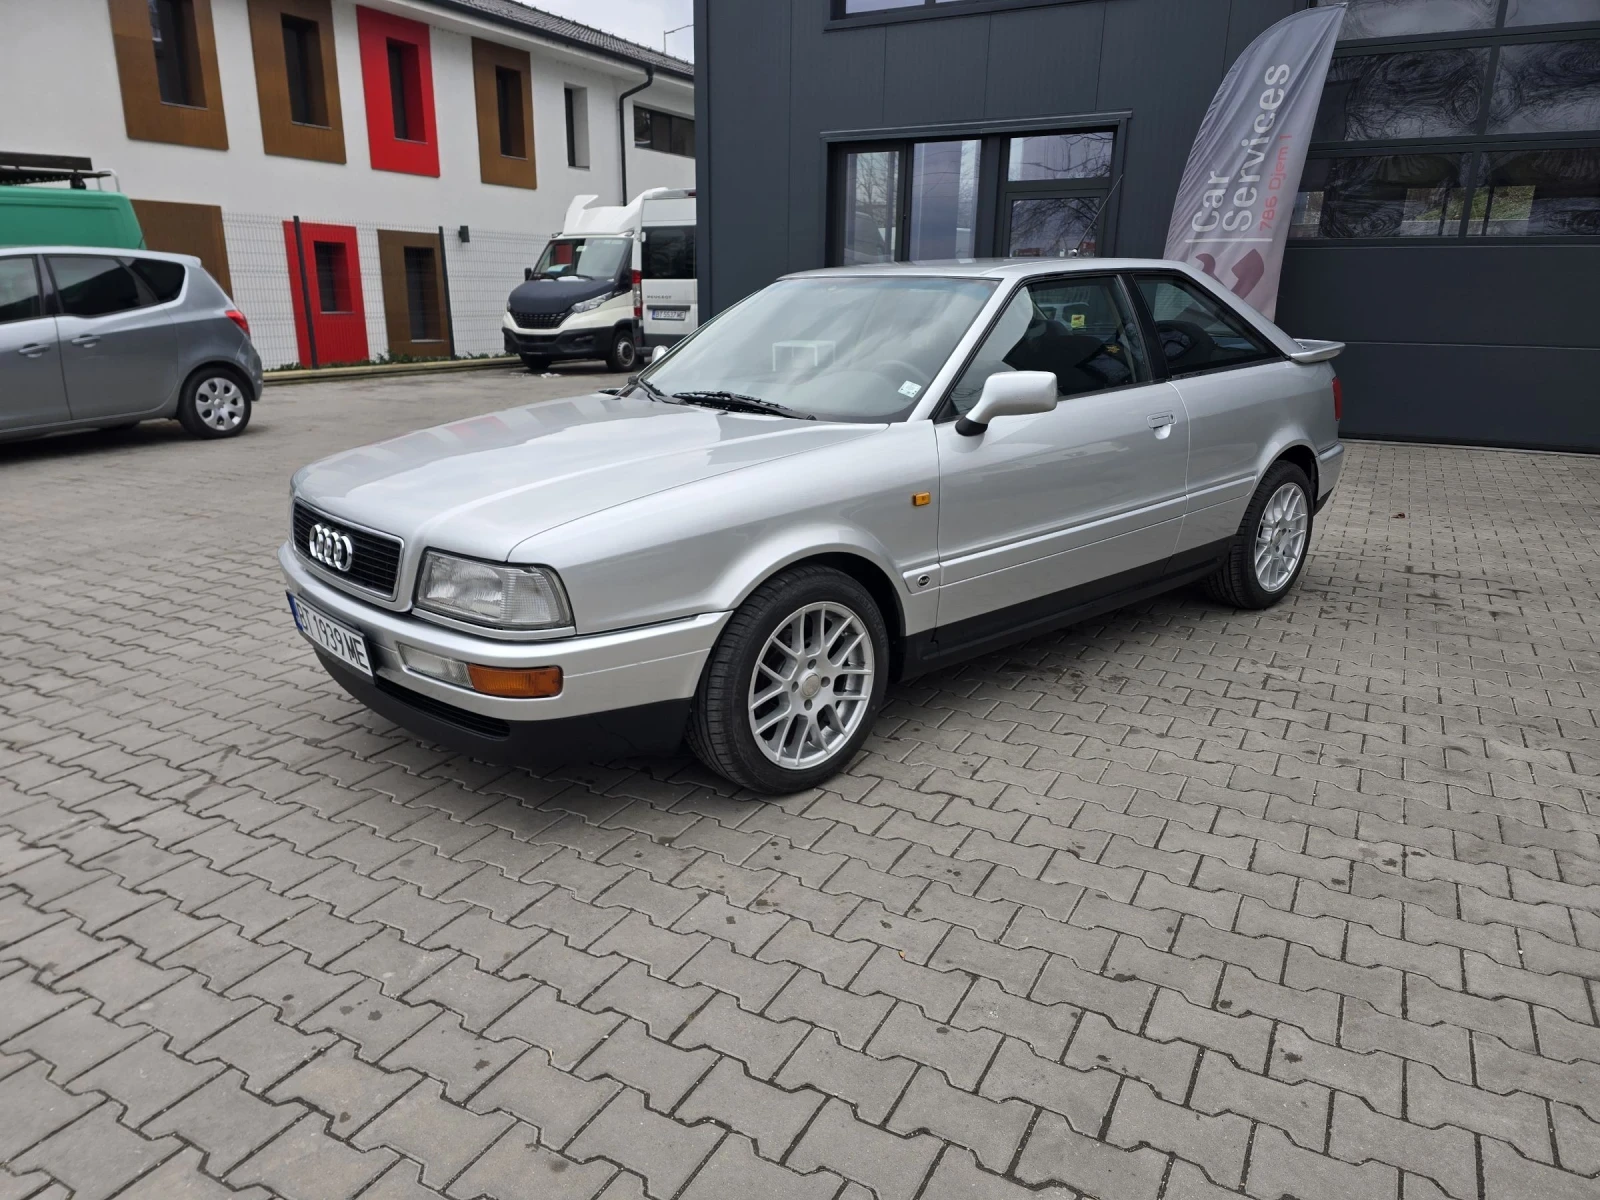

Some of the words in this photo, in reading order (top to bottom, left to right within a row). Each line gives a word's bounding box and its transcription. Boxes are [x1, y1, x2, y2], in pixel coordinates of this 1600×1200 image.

[1222, 64, 1290, 232] Services
[1191, 170, 1230, 233] Car
[313, 614, 345, 657] 1939
[343, 632, 370, 671] ME
